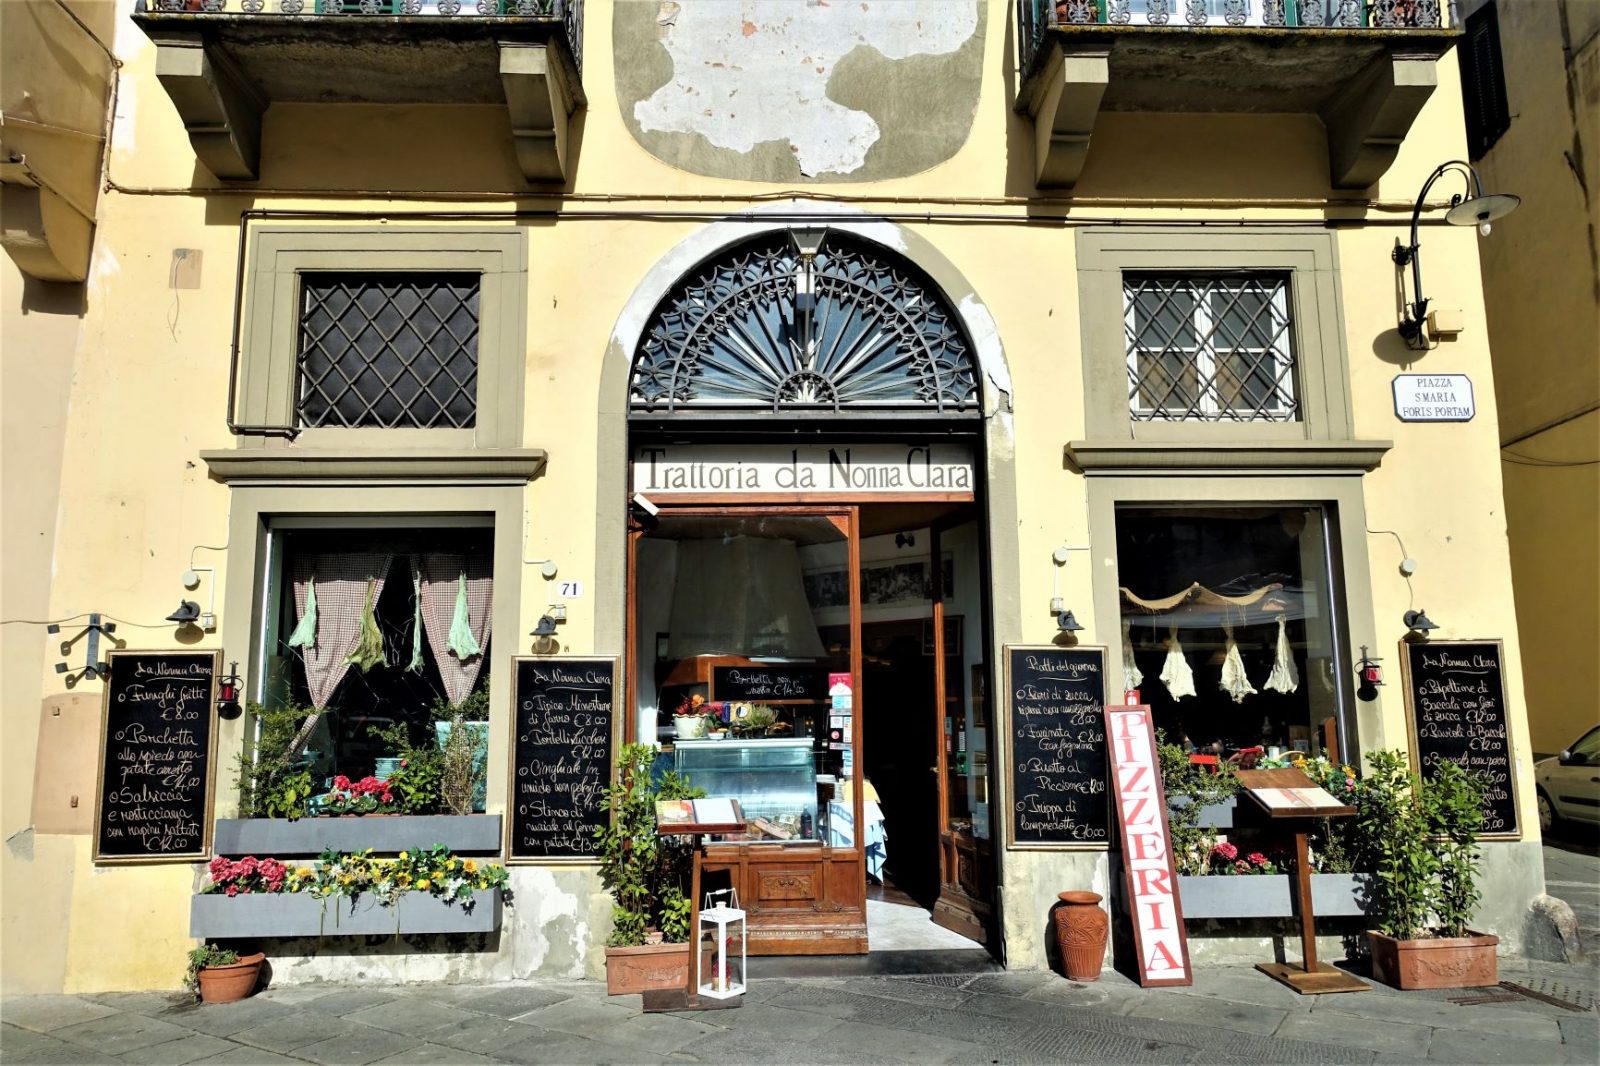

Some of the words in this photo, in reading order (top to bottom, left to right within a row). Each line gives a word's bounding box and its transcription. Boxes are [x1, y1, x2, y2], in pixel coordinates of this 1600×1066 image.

[1417, 378, 1452, 388] PIAZZA
[1403, 407, 1432, 416] FORIS
[1434, 407, 1470, 416] PORTAM
[641, 447, 760, 490] Trattoria
[774, 448, 816, 489] da
[828, 447, 904, 489] Nonna
[906, 447, 971, 489] Clara
[562, 582, 577, 596] 71
[154, 662, 188, 676] Nonna
[190, 664, 212, 675] Clara
[1026, 656, 1056, 672] Piatti
[1056, 659, 1070, 672] del
[1439, 652, 1472, 668] Nonna
[1473, 654, 1498, 669] Clara
[550, 668, 584, 683] Nonna
[586, 670, 611, 685] Clara
[126, 684, 176, 708] Funghi
[176, 686, 207, 710] fritti
[1052, 685, 1062, 700] di
[1064, 690, 1094, 702] zucca
[1424, 678, 1476, 700] Polpettine
[1478, 680, 1488, 694] di
[532, 694, 564, 712] Tipico
[1043, 706, 1059, 715] con
[1462, 700, 1478, 709] con
[528, 712, 539, 724] di
[542, 712, 570, 732] farro
[1422, 710, 1432, 721] di
[1435, 712, 1462, 722] zucca
[125, 722, 198, 746] Porchetta
[528, 728, 570, 746] Tortelli
[1022, 722, 1073, 739] Farinata
[1426, 722, 1464, 738] Ravioli
[1466, 724, 1476, 738] di
[118, 746, 136, 762] allo
[139, 747, 175, 764] spiedo
[178, 750, 204, 760] con
[121, 761, 156, 784] patate
[156, 760, 192, 775] arrosto
[530, 756, 580, 782] Cinghiale
[586, 760, 600, 776] in
[1026, 757, 1066, 773] Risotto
[1067, 760, 1082, 774] al
[522, 778, 551, 794] umido
[554, 782, 570, 792] con
[570, 776, 606, 803] polenta
[1034, 776, 1081, 792] Piccione
[120, 784, 192, 804] Salsiccia
[108, 810, 118, 822] e
[530, 798, 570, 818] Stinco
[570, 806, 584, 818] di
[1024, 794, 1064, 820] Trippa
[107, 828, 124, 837] con
[164, 820, 200, 836] saltati
[526, 818, 560, 832] maiale
[562, 820, 574, 832] al
[574, 820, 599, 840] forno
[1020, 813, 1076, 838] lampredotto
[524, 836, 542, 846] con
[544, 832, 572, 854] patate
[1113, 713, 1183, 972] PIZZERIA
